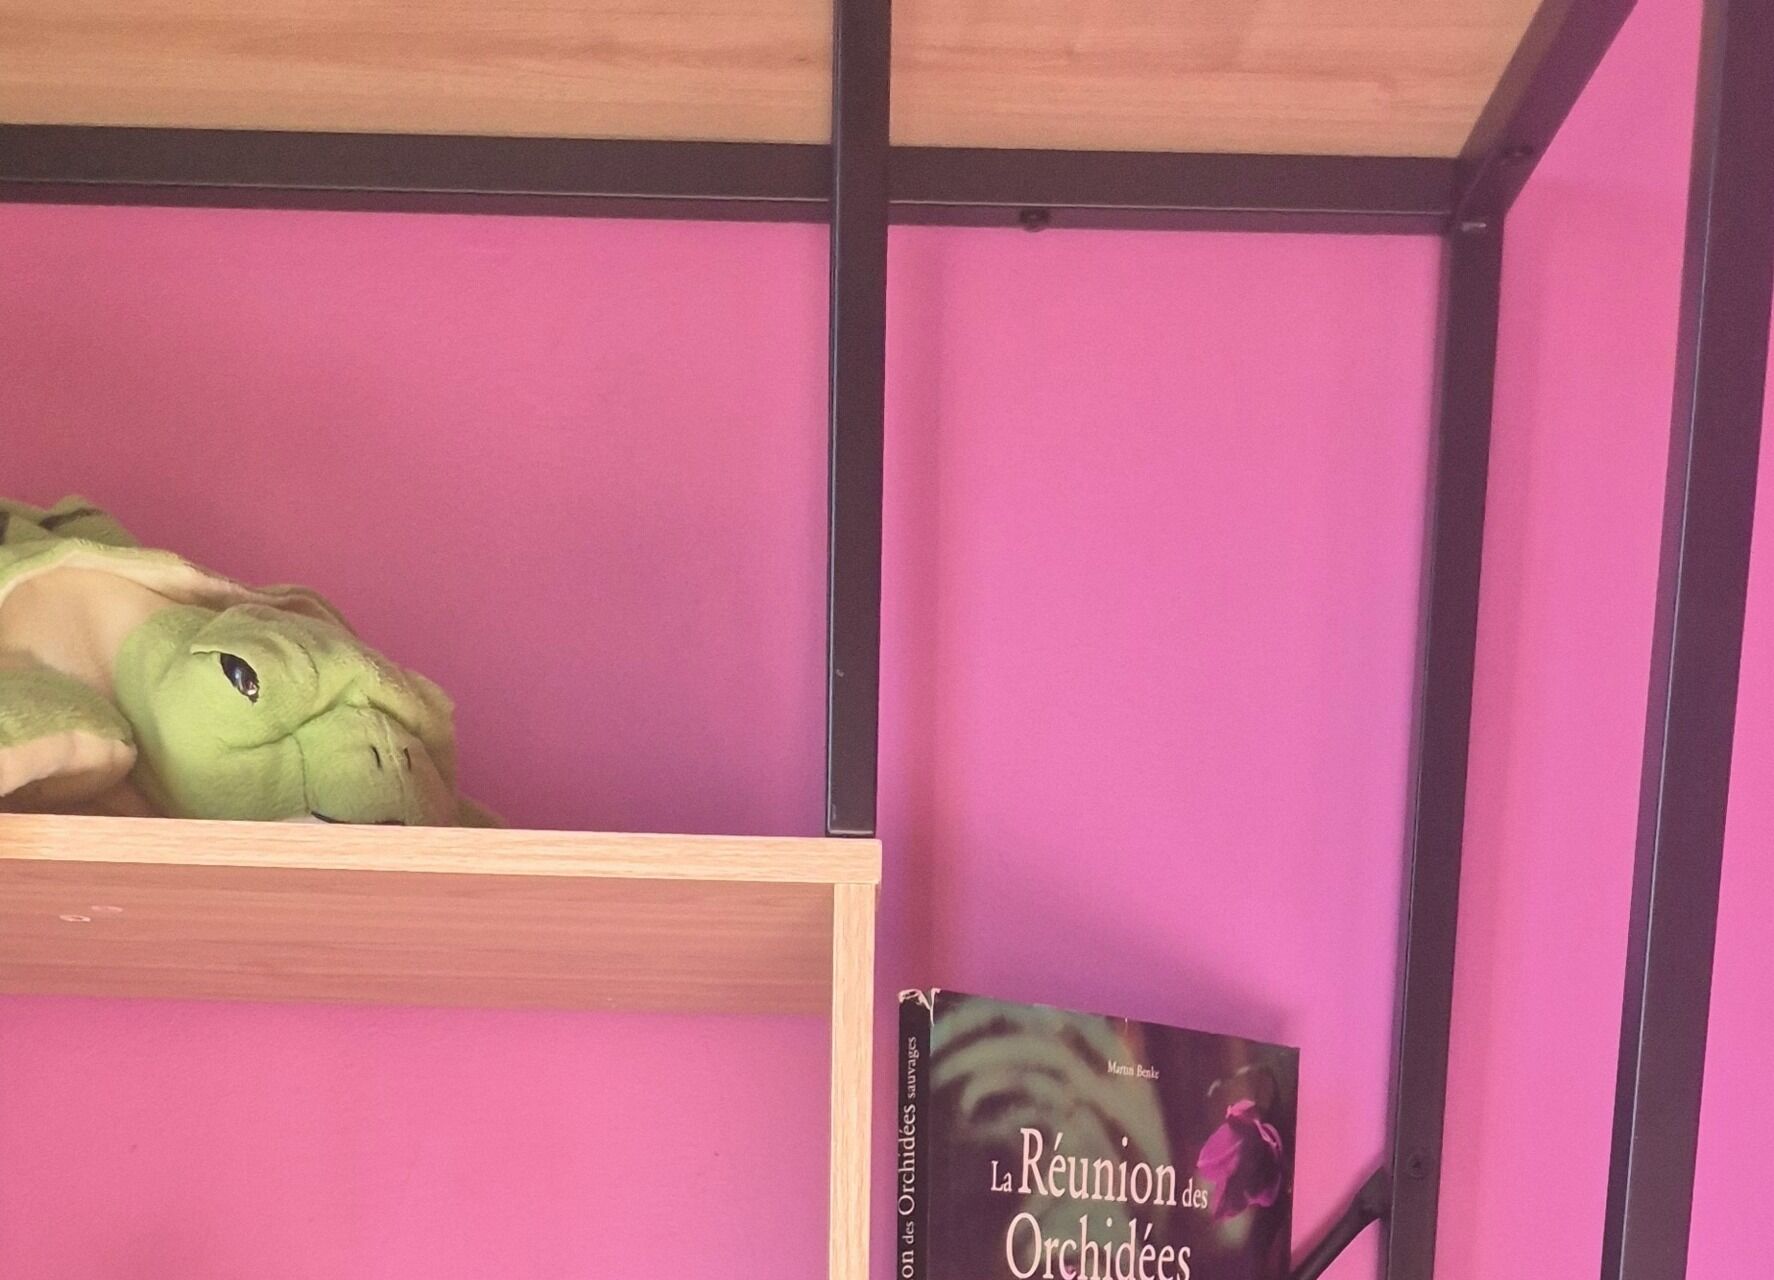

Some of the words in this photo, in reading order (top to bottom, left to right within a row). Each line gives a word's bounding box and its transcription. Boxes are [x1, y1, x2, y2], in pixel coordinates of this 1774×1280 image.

[905, 1036, 920, 1100] sauvages
[1107, 1059, 1134, 1076] Martin
[897, 1104, 917, 1217] Orchidées
[990, 1160, 1013, 1193] La
[1018, 1127, 1178, 1206] Réunion
[1181, 1177, 1209, 1209] des
[902, 1220, 914, 1245] des
